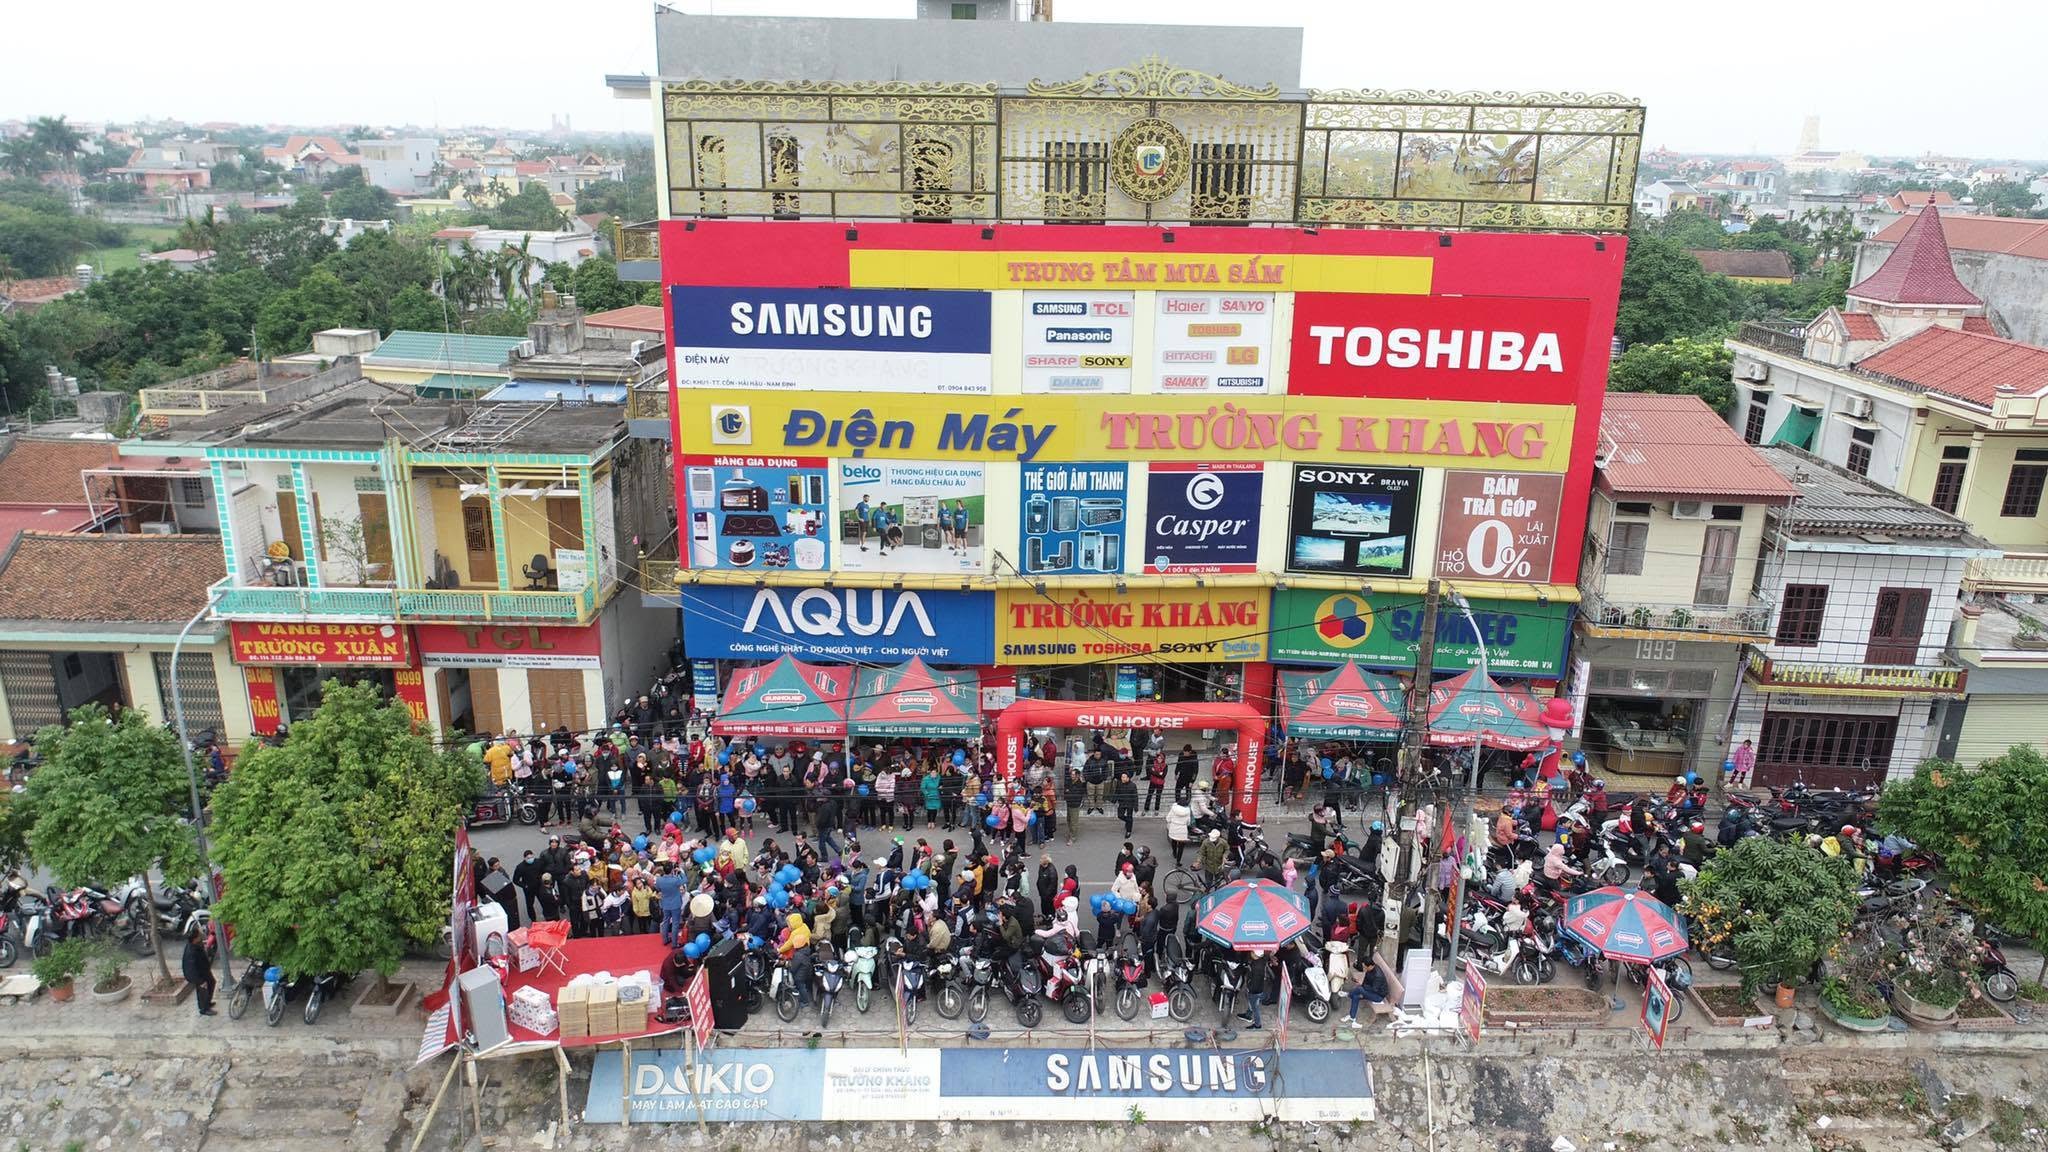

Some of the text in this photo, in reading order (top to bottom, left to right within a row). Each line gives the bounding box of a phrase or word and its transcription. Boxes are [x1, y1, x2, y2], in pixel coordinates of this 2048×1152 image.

[1008, 255, 1285, 284] TRUNG TÂM MUA SẮM
[1037, 303, 1083, 314] SAMSUNG
[1093, 303, 1129, 316] TCL
[1167, 299, 1205, 312] Haier
[1222, 300, 1265, 312] SANYO
[730, 301, 933, 338] SAMSUNG
[1047, 330, 1112, 341] Panasonic
[1192, 326, 1237, 335] TOSHIBA
[1310, 325, 1563, 372] TOSHIBA
[685, 354, 730, 365] ĐIỆN MÁY
[1028, 357, 1077, 366] SHARP
[1085, 357, 1127, 366] SONY
[1165, 352, 1212, 361] HITACHI
[1231, 349, 1255, 362] LG
[1052, 378, 1101, 387] DAIKIN
[1164, 377, 1206, 387] SANAKY
[1218, 378, 1261, 387] MITSUBISHI
[783, 404, 1057, 461] Điện Máy
[1101, 402, 1548, 460] TRƯỜNG KHANG
[714, 455, 798, 470] HÀNG GIA DỤNG
[843, 464, 881, 479] beko
[1024, 466, 1124, 491] THẾ GIỚI ÂM THANH
[1483, 475, 1519, 496] BÁN
[1463, 495, 1537, 517] TRẢ GÓP
[1156, 515, 1246, 541] Casper
[1527, 521, 1544, 532] LÃI
[1443, 548, 1464, 561] HỖ
[1467, 519, 1531, 578] 0%
[1440, 560, 1465, 574] TRỢ
[742, 588, 936, 637] AQUA
[1010, 590, 1258, 628] TRƯỜNG KHANG
[327, 625, 375, 638] BẠC
[457, 625, 555, 650] TCL
[334, 639, 399, 655] XUÂN
[730, 643, 754, 652] CÔNG
[756, 643, 782, 654] NGHỆ
[854, 645, 873, 656] VIỆT
[881, 647, 899, 655] CHO
[931, 647, 949, 657] VIỆT
[1003, 643, 1077, 655] SAMSUNG
[1082, 642, 1152, 654] TOSHIBA
[1159, 642, 1217, 653] SONY
[1223, 639, 1260, 653] beko
[1636, 640, 1676, 661] 1993
[1467, 657, 1539, 669] WW.SAMNEC.COM
[396, 671, 422, 686] 9999
[252, 695, 278, 717] VÀNG
[1077, 715, 1184, 728] SUNHOUSE
[1243, 741, 1259, 804] SUNHOUSE
[1046, 1053, 1266, 1092] SAMSUNG
[886, 1075, 931, 1087] KHANG
[716, 1099, 742, 1109] CAO
